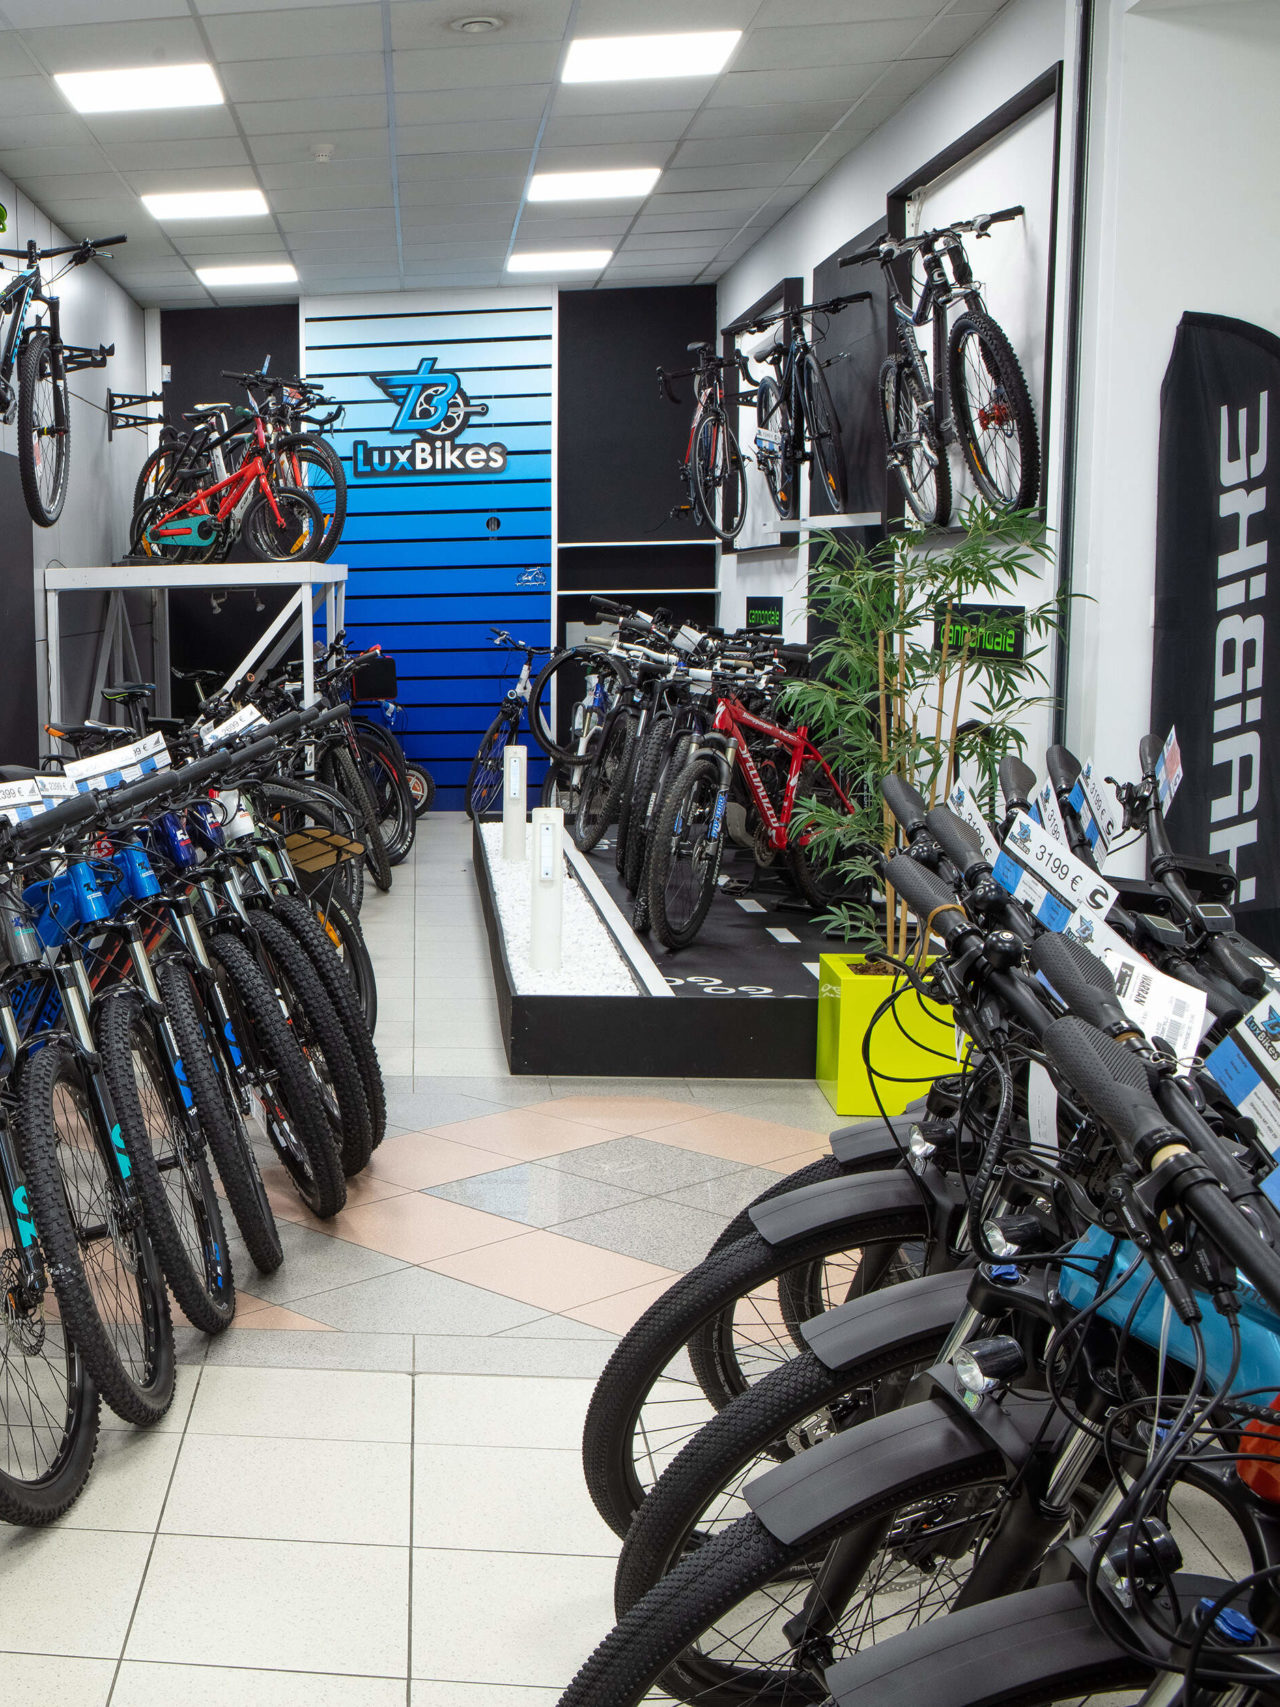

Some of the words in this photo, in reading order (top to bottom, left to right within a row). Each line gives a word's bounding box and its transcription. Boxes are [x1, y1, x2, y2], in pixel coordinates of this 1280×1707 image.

[357, 440, 505, 473] LuxBikes
[17, 787, 25, 798] €
[1092, 782, 1102, 811] 3199
[1035, 844, 1070, 881] 3199
[1070, 874, 1083, 892] €
[1244, 1015, 1280, 1062] LuxBikes
